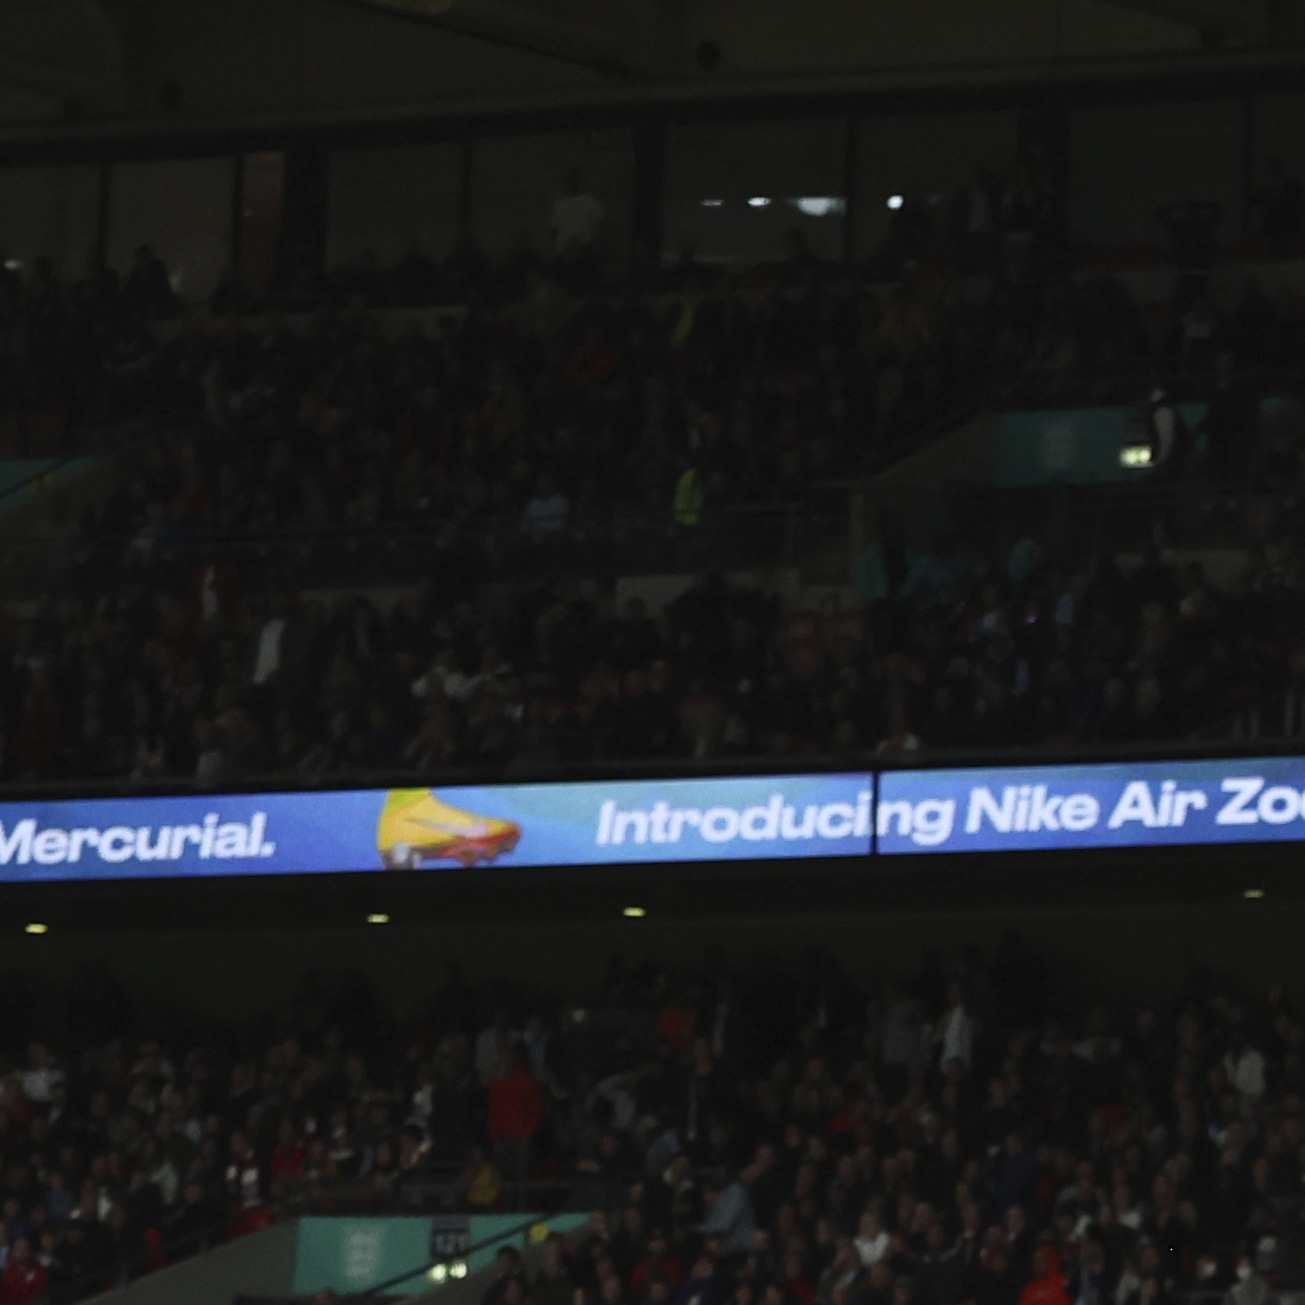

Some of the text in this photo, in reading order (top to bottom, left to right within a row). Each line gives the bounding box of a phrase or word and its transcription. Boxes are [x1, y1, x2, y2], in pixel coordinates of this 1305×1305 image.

[595, 789, 957, 846] Introducing
[964, 784, 1100, 834] Nike
[1107, 779, 1208, 829] Air
